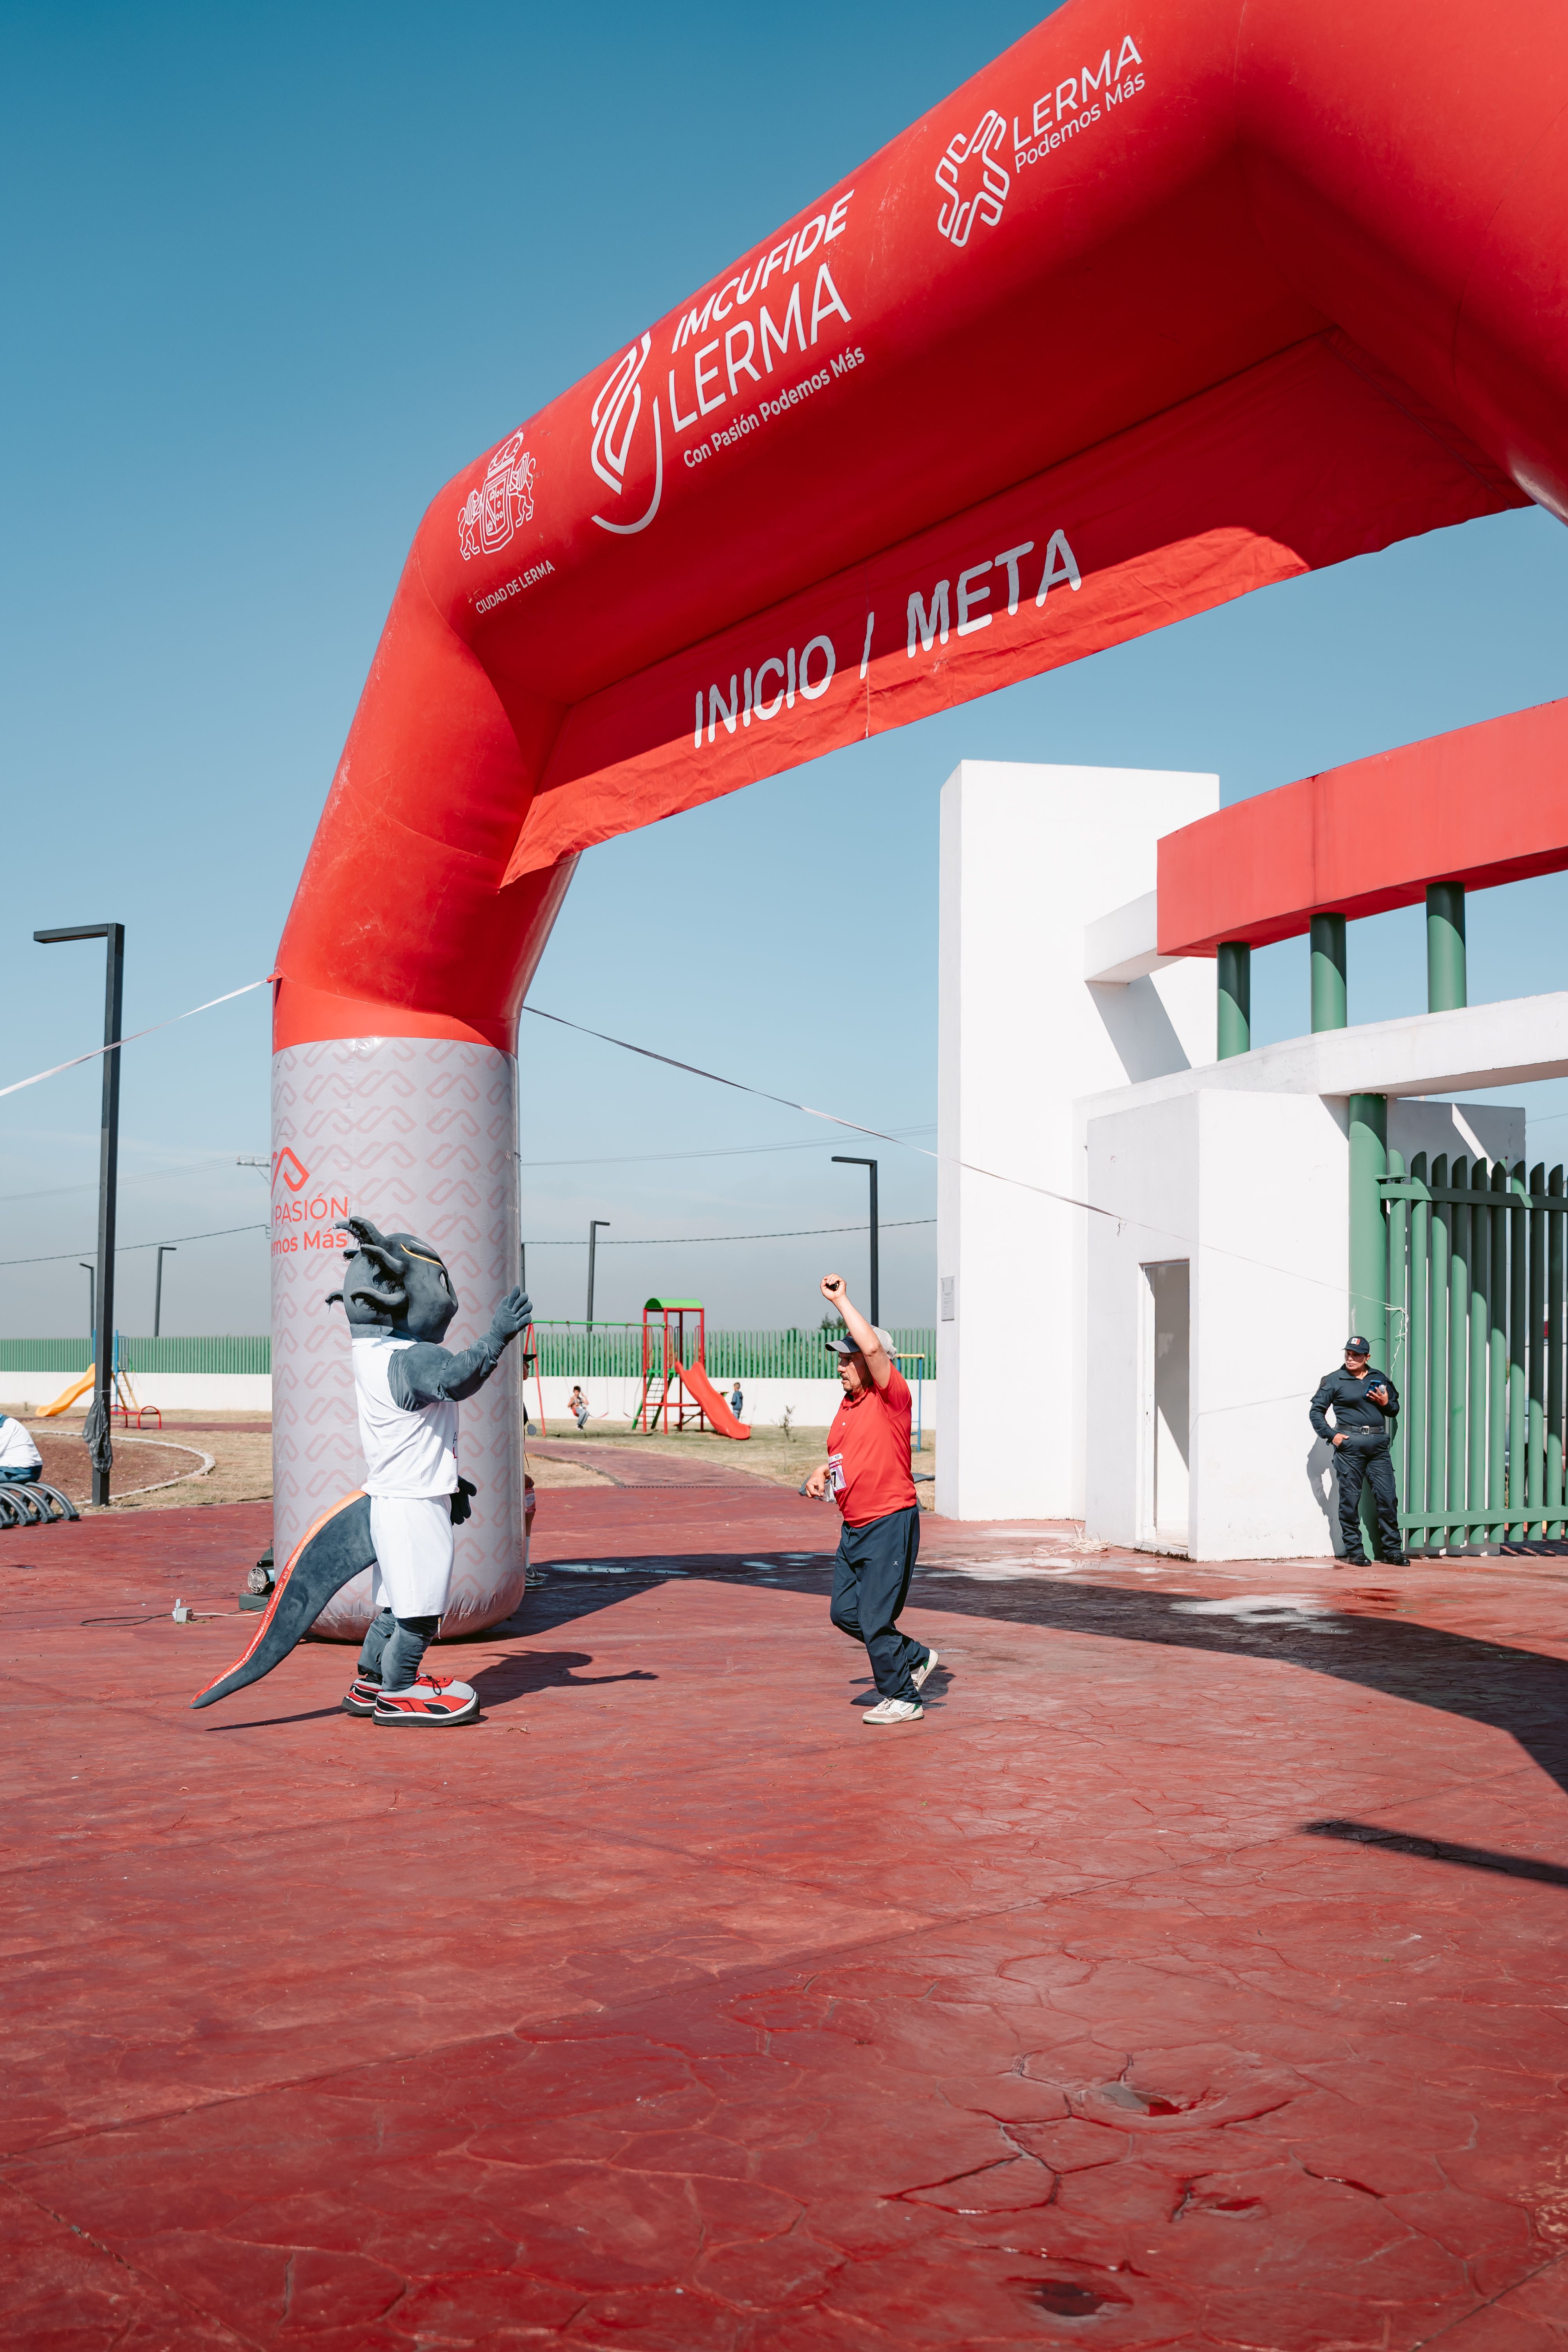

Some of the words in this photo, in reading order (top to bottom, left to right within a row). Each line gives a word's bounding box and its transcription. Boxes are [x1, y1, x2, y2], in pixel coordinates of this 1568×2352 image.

[1013, 35, 1143, 152] LERMA
[1015, 103, 1101, 174] Podemos
[1105, 73, 1146, 112] Más
[671, 189, 855, 354] IMCUFIDE
[669, 263, 852, 433] LERMA
[683, 443, 712, 468] Con
[711, 414, 760, 452] Pasión
[759, 369, 830, 422] Podemos
[830, 347, 865, 378] Más
[476, 588, 507, 614] CIUDAD
[506, 579, 521, 596] DE
[518, 560, 555, 589] LERMA
[694, 635, 836, 749] INICIO
[907, 529, 1082, 659] META
[276, 1193, 348, 1226] PASIÓN
[304, 1228, 348, 1250] Más
